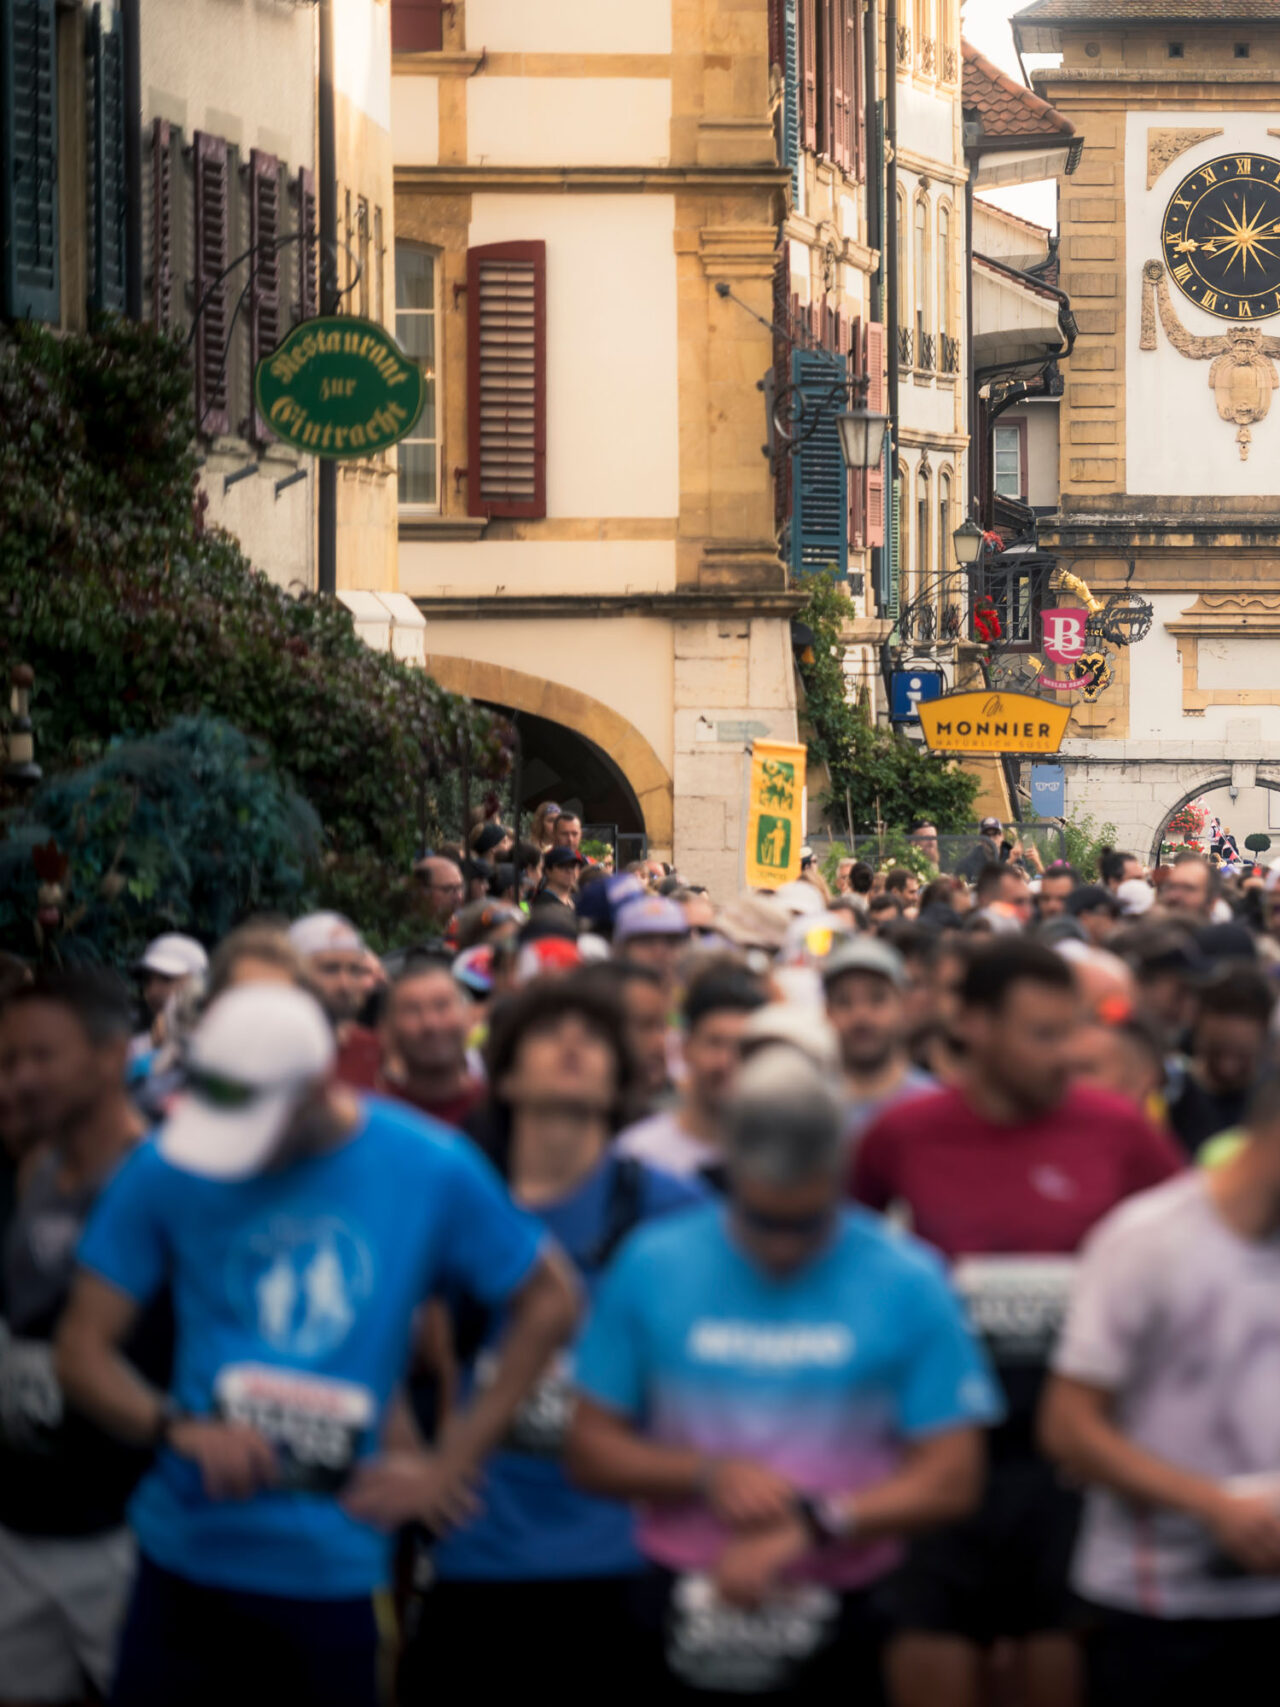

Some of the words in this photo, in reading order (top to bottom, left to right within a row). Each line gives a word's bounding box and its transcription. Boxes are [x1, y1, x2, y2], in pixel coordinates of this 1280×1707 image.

[1235, 158, 1251, 175] XII
[1199, 167, 1217, 185] XI
[1174, 194, 1193, 212] X
[1165, 230, 1182, 244] IX
[1172, 265, 1194, 284] VIII
[1200, 289, 1217, 311] VII
[1238, 300, 1252, 317] VI
[270, 329, 409, 387] Restaurant
[320, 377, 357, 401] zur
[270, 395, 407, 449] Eintracht
[1049, 617, 1081, 651] B
[936, 721, 1050, 738] MONNIER
